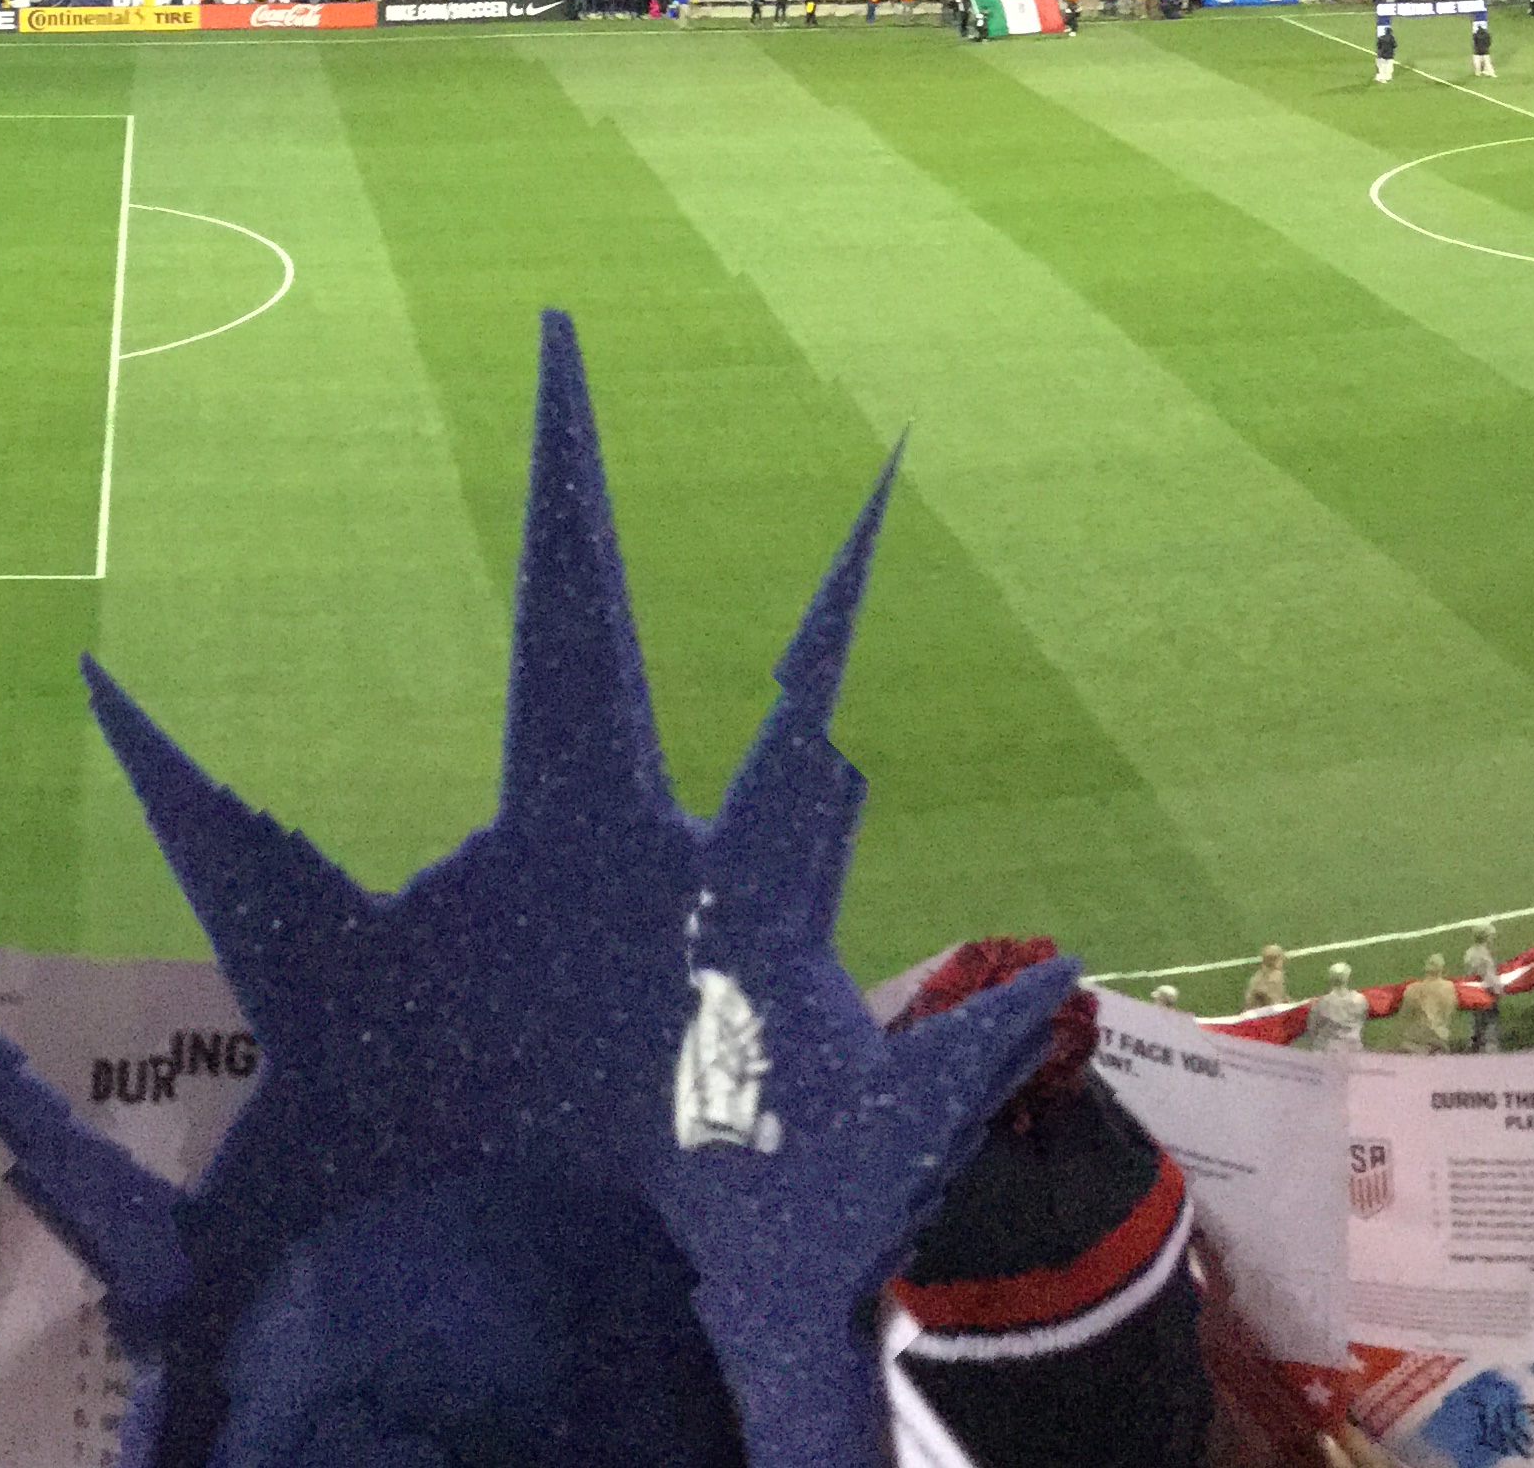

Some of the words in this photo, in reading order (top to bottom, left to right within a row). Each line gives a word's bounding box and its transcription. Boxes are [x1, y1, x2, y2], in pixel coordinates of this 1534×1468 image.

[27, 9, 131, 30] Continental
[155, 11, 193, 26] TIRE
[87, 1029, 263, 1107] DURING
